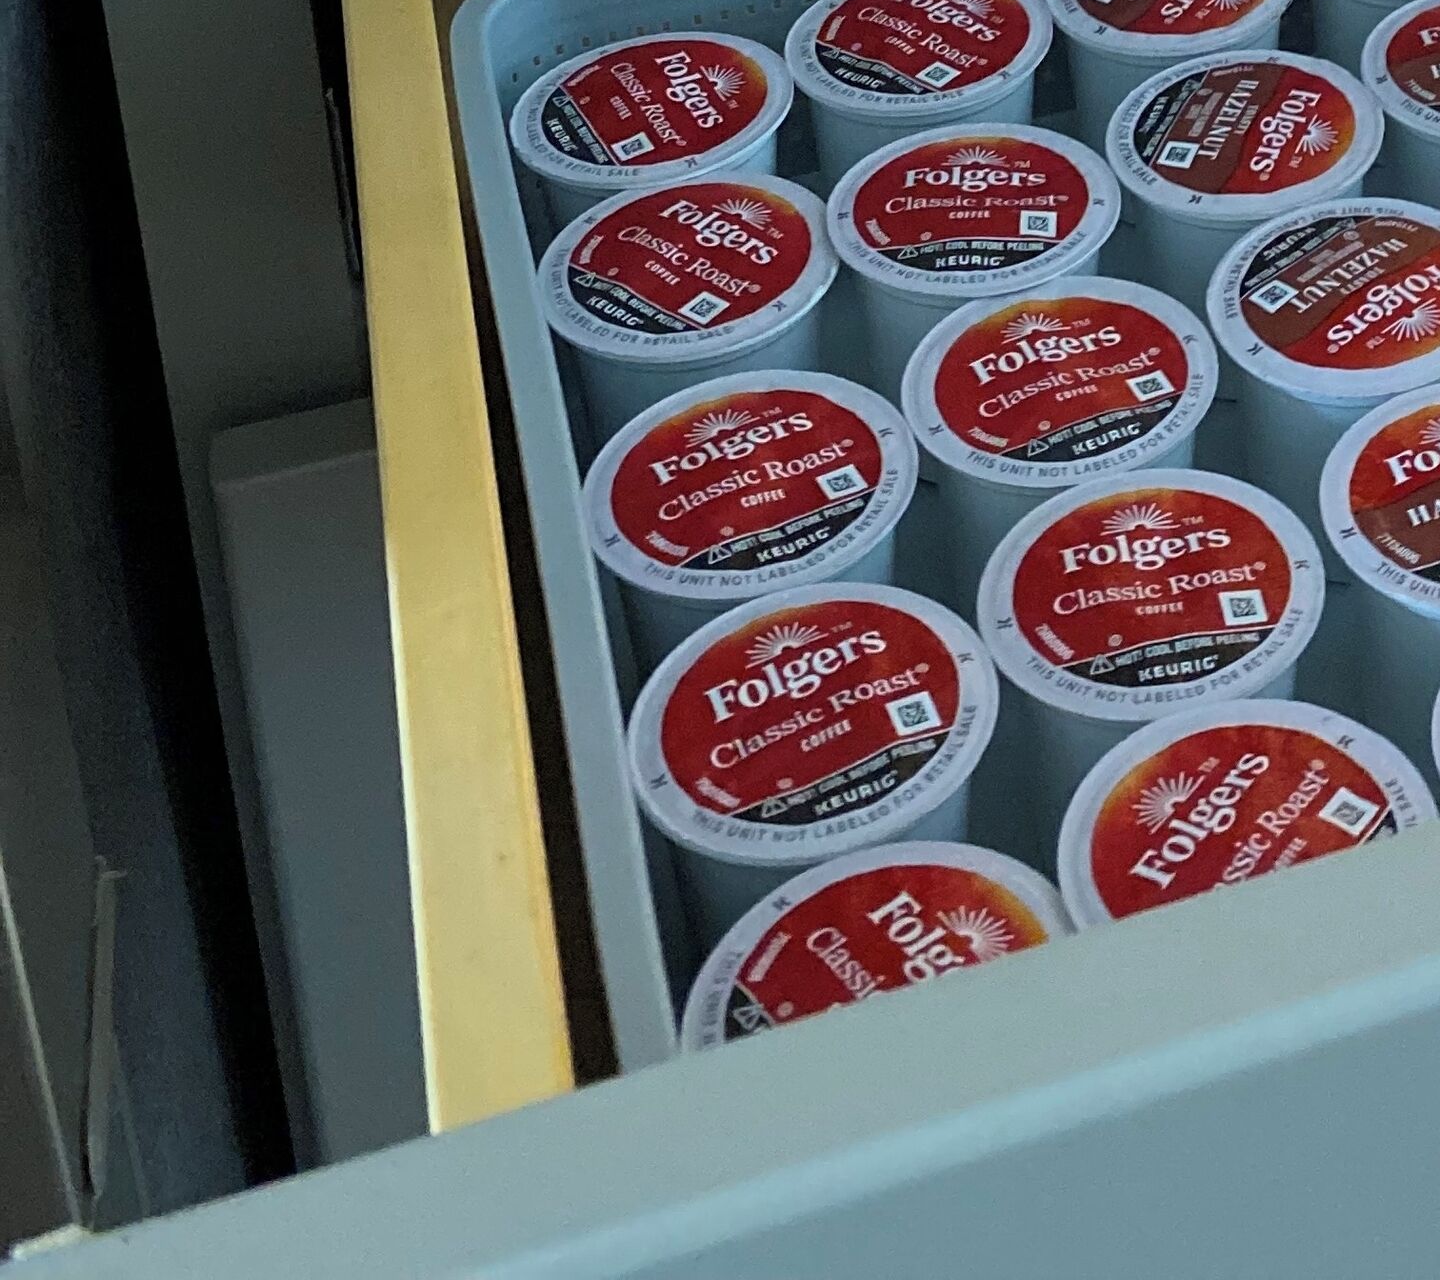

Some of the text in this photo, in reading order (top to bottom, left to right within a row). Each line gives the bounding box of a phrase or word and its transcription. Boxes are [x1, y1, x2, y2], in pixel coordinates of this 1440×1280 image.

[857, 6, 979, 68] Classic Roast
[655, 50, 723, 128] Folgers
[834, 67, 885, 88] KEURIG
[611, 63, 682, 144] Classic Roast
[1198, 79, 1260, 160] HAZELNUT
[1250, 89, 1322, 174] Folgers
[885, 194, 1054, 214] Classic Roast
[904, 166, 1046, 192] Folgers
[659, 200, 779, 265] Folgers
[949, 210, 990, 219] COFFEE
[617, 226, 689, 266] Classic
[686, 257, 751, 297] Roast
[645, 260, 680, 286] COFFEE
[936, 256, 1004, 268] KEURIG
[1289, 237, 1409, 315] HAZELNUT
[586, 296, 644, 327] KEURIG
[614, 332, 638, 342] FOR
[968, 325, 1122, 386] Folgers
[978, 353, 1153, 419] Classic Roast
[648, 411, 813, 486] Folgers
[966, 429, 1165, 478] THIS UNIT NOT LABELED FOR
[1071, 422, 1141, 457] KEURIG
[658, 442, 846, 521] Classic Roast
[740, 489, 787, 508] COFFEE
[678, 572, 713, 586] UNIT
[719, 574, 751, 586] NOT
[756, 551, 826, 583] LABELED
[829, 531, 855, 554] FOR
[756, 526, 831, 564] KEURIG
[1058, 527, 1232, 575] Folgers
[1052, 565, 1258, 616] Classic Roast
[1375, 561, 1406, 586] THIS
[1135, 601, 1183, 616] COFFEE
[703, 629, 888, 724] Folgers
[1025, 655, 1241, 705] THIS UNIT NOT LABELED FOR
[1138, 655, 1220, 683] KEURIG
[709, 669, 918, 770] Classic Roast
[814, 769, 898, 817] KEURIG
[1256, 768, 1330, 838] Roast
[815, 804, 890, 840] LABELED
[1129, 752, 1271, 891] Folgers
[806, 926, 886, 1000] Classi
[866, 890, 965, 985] Folg
